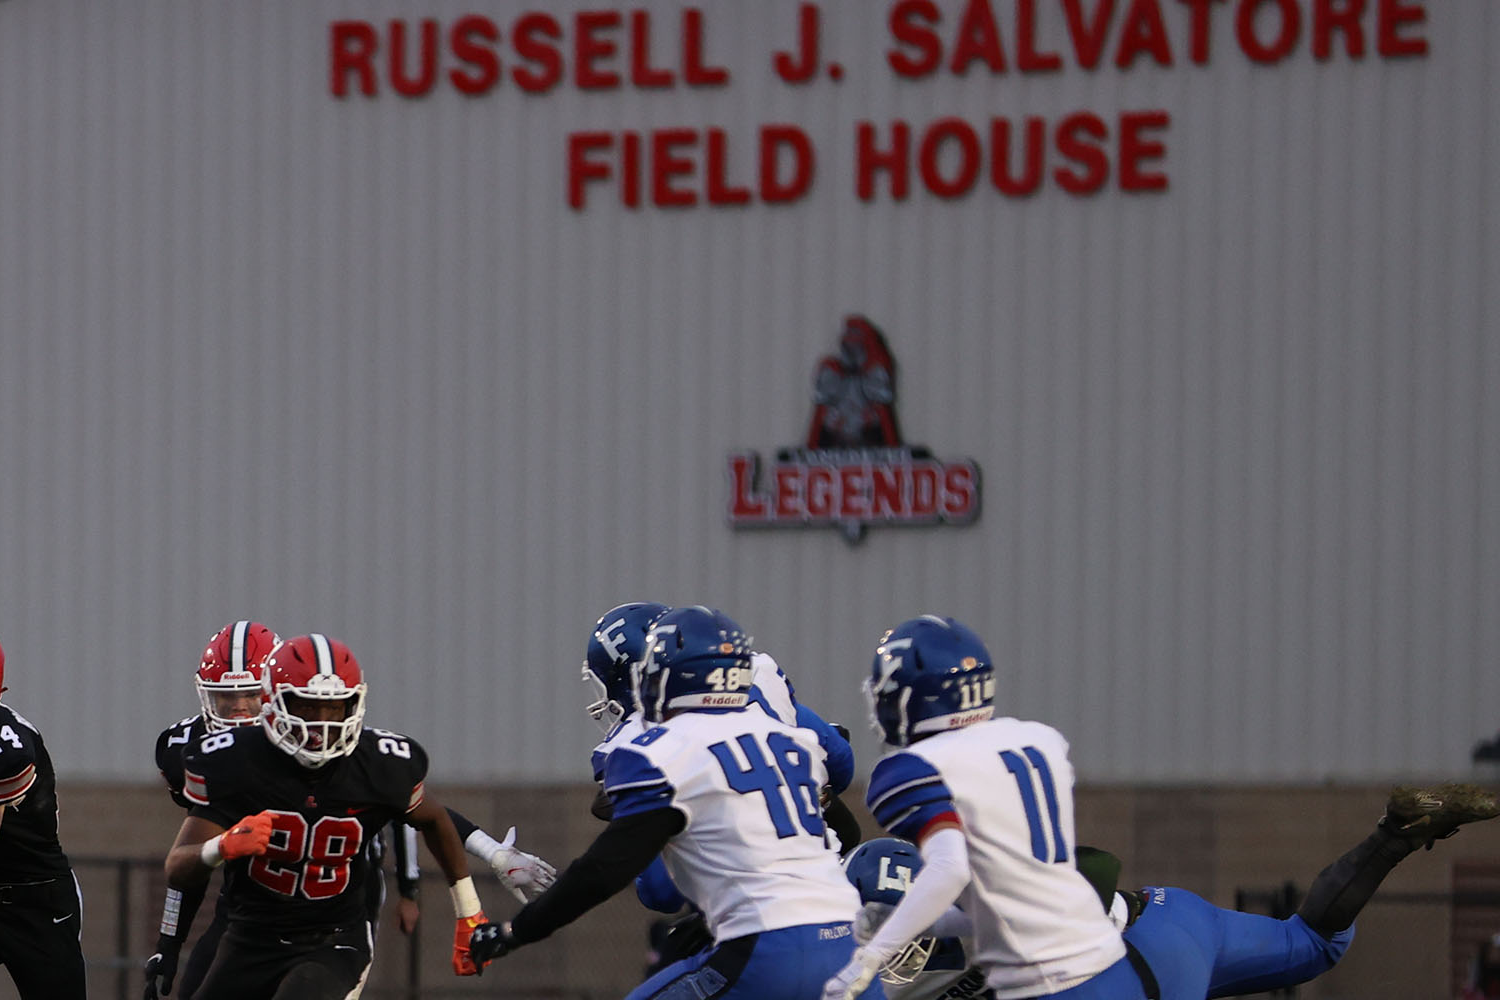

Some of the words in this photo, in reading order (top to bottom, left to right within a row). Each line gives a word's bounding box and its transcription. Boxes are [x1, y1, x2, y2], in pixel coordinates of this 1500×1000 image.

[331, 8, 729, 98] RUSSELL
[775, 0, 843, 83] J.
[888, 0, 1428, 78] SALVATORE
[568, 124, 815, 211] FIELD
[857, 111, 1170, 202] HOUSE
[730, 454, 975, 517] LEGENDS
[702, 695, 744, 705] Riddell
[705, 667, 741, 691] 48
[707, 731, 824, 839] 48
[998, 745, 1068, 864] 11
[248, 809, 364, 900] 28
